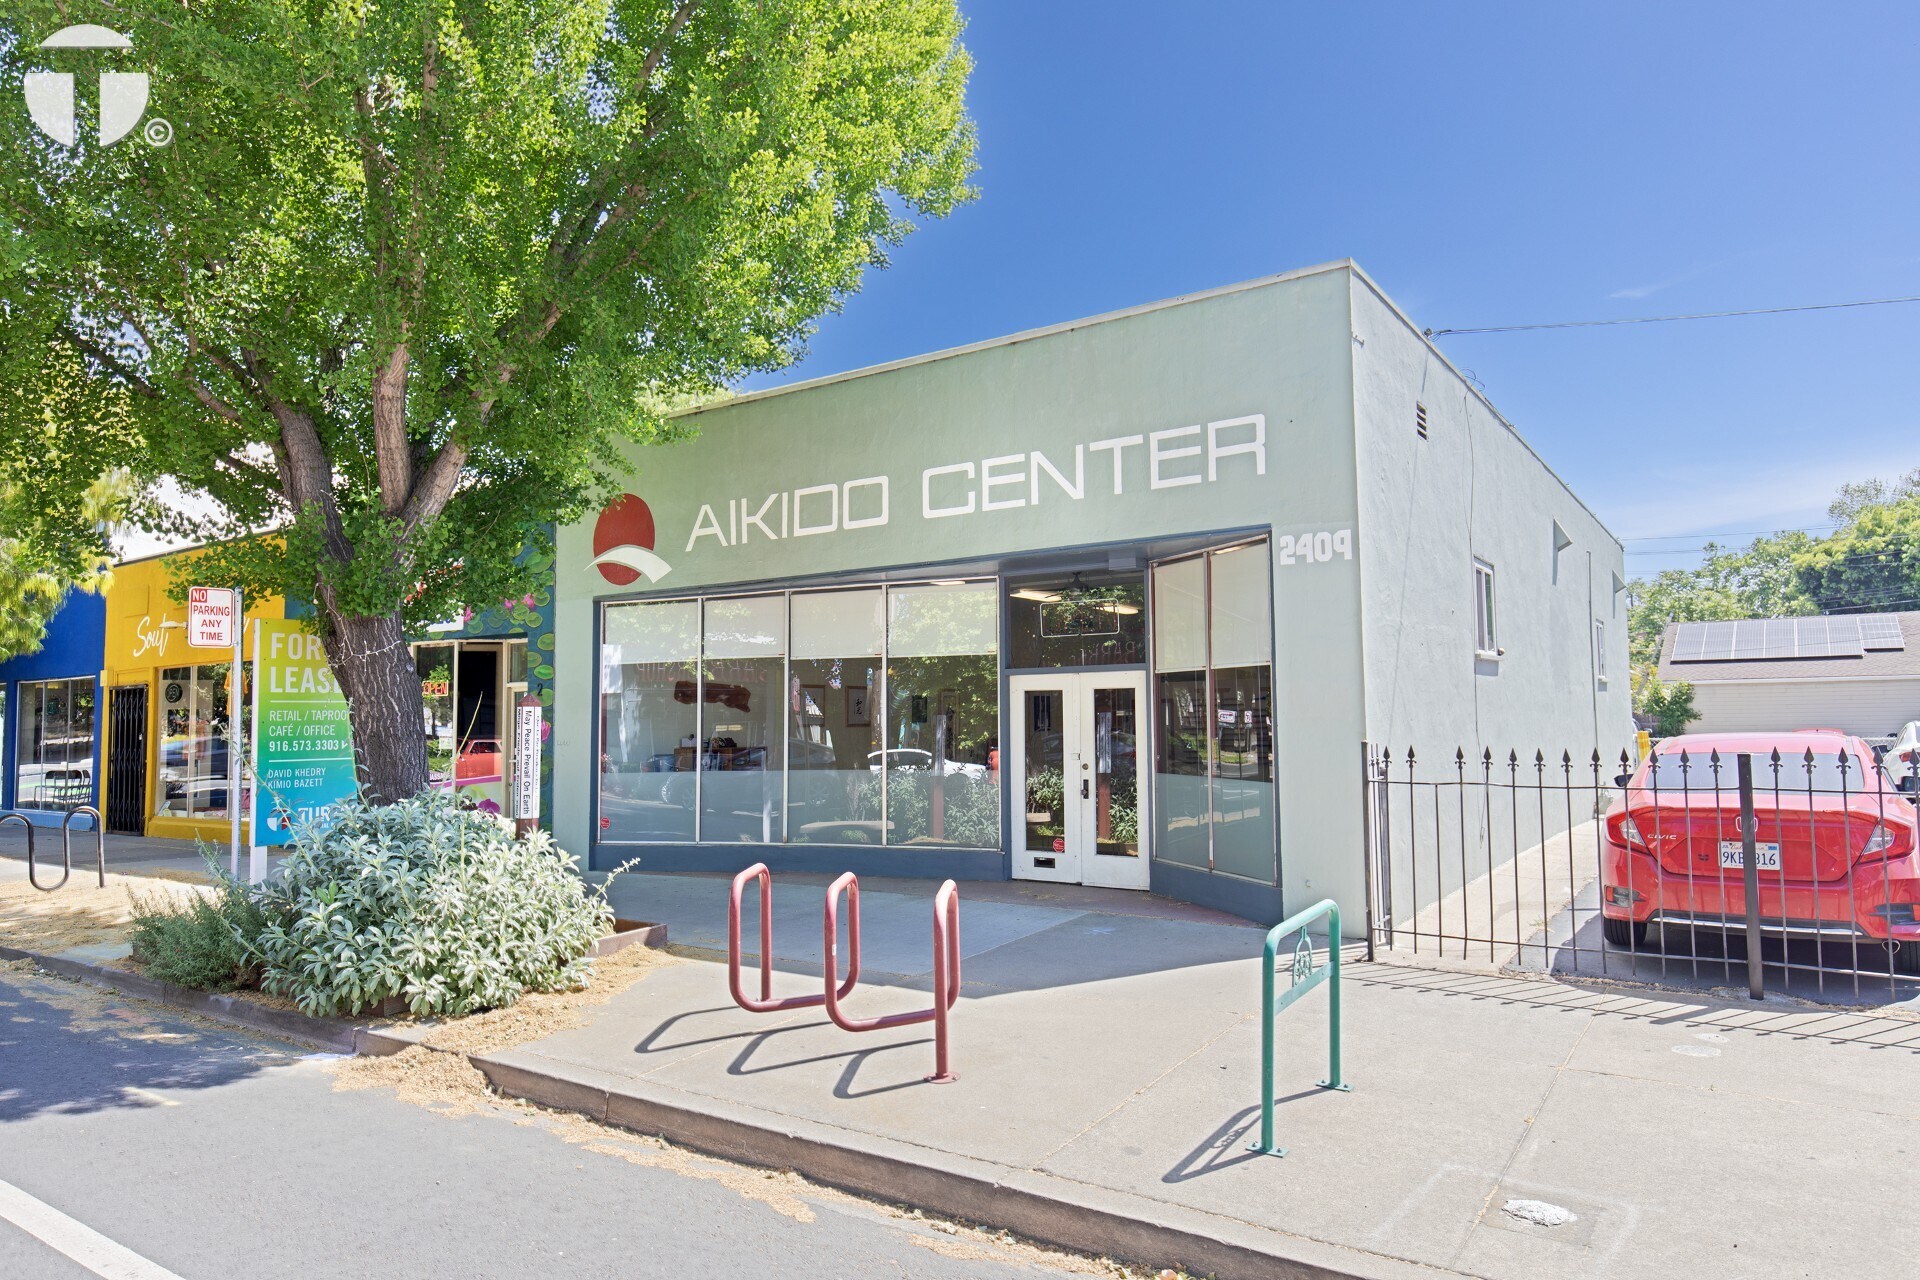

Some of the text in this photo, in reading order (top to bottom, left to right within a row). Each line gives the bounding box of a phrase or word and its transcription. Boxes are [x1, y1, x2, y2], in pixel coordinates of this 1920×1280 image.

[685, 413, 1266, 552] AIKIDO CENTER
[1279, 529, 1352, 566] 2409
[192, 590, 207, 602] NO
[193, 605, 230, 616] PARKING
[201, 619, 222, 628] ANY
[200, 631, 223, 641] TIME
[271, 632, 322, 660] FOR
[536, 682, 543, 696] 2
[269, 710, 301, 722] RETAIL
[311, 709, 347, 721] TAPROO
[269, 724, 294, 737] CAFÉ
[303, 724, 336, 736] OFFICE
[269, 740, 339, 752] 916.573.3303
[523, 710, 532, 815] May Peace Prevail On Earth
[268, 767, 326, 778] DAVID KHEDRY
[268, 778, 324, 789] KIMIO BAZETT
